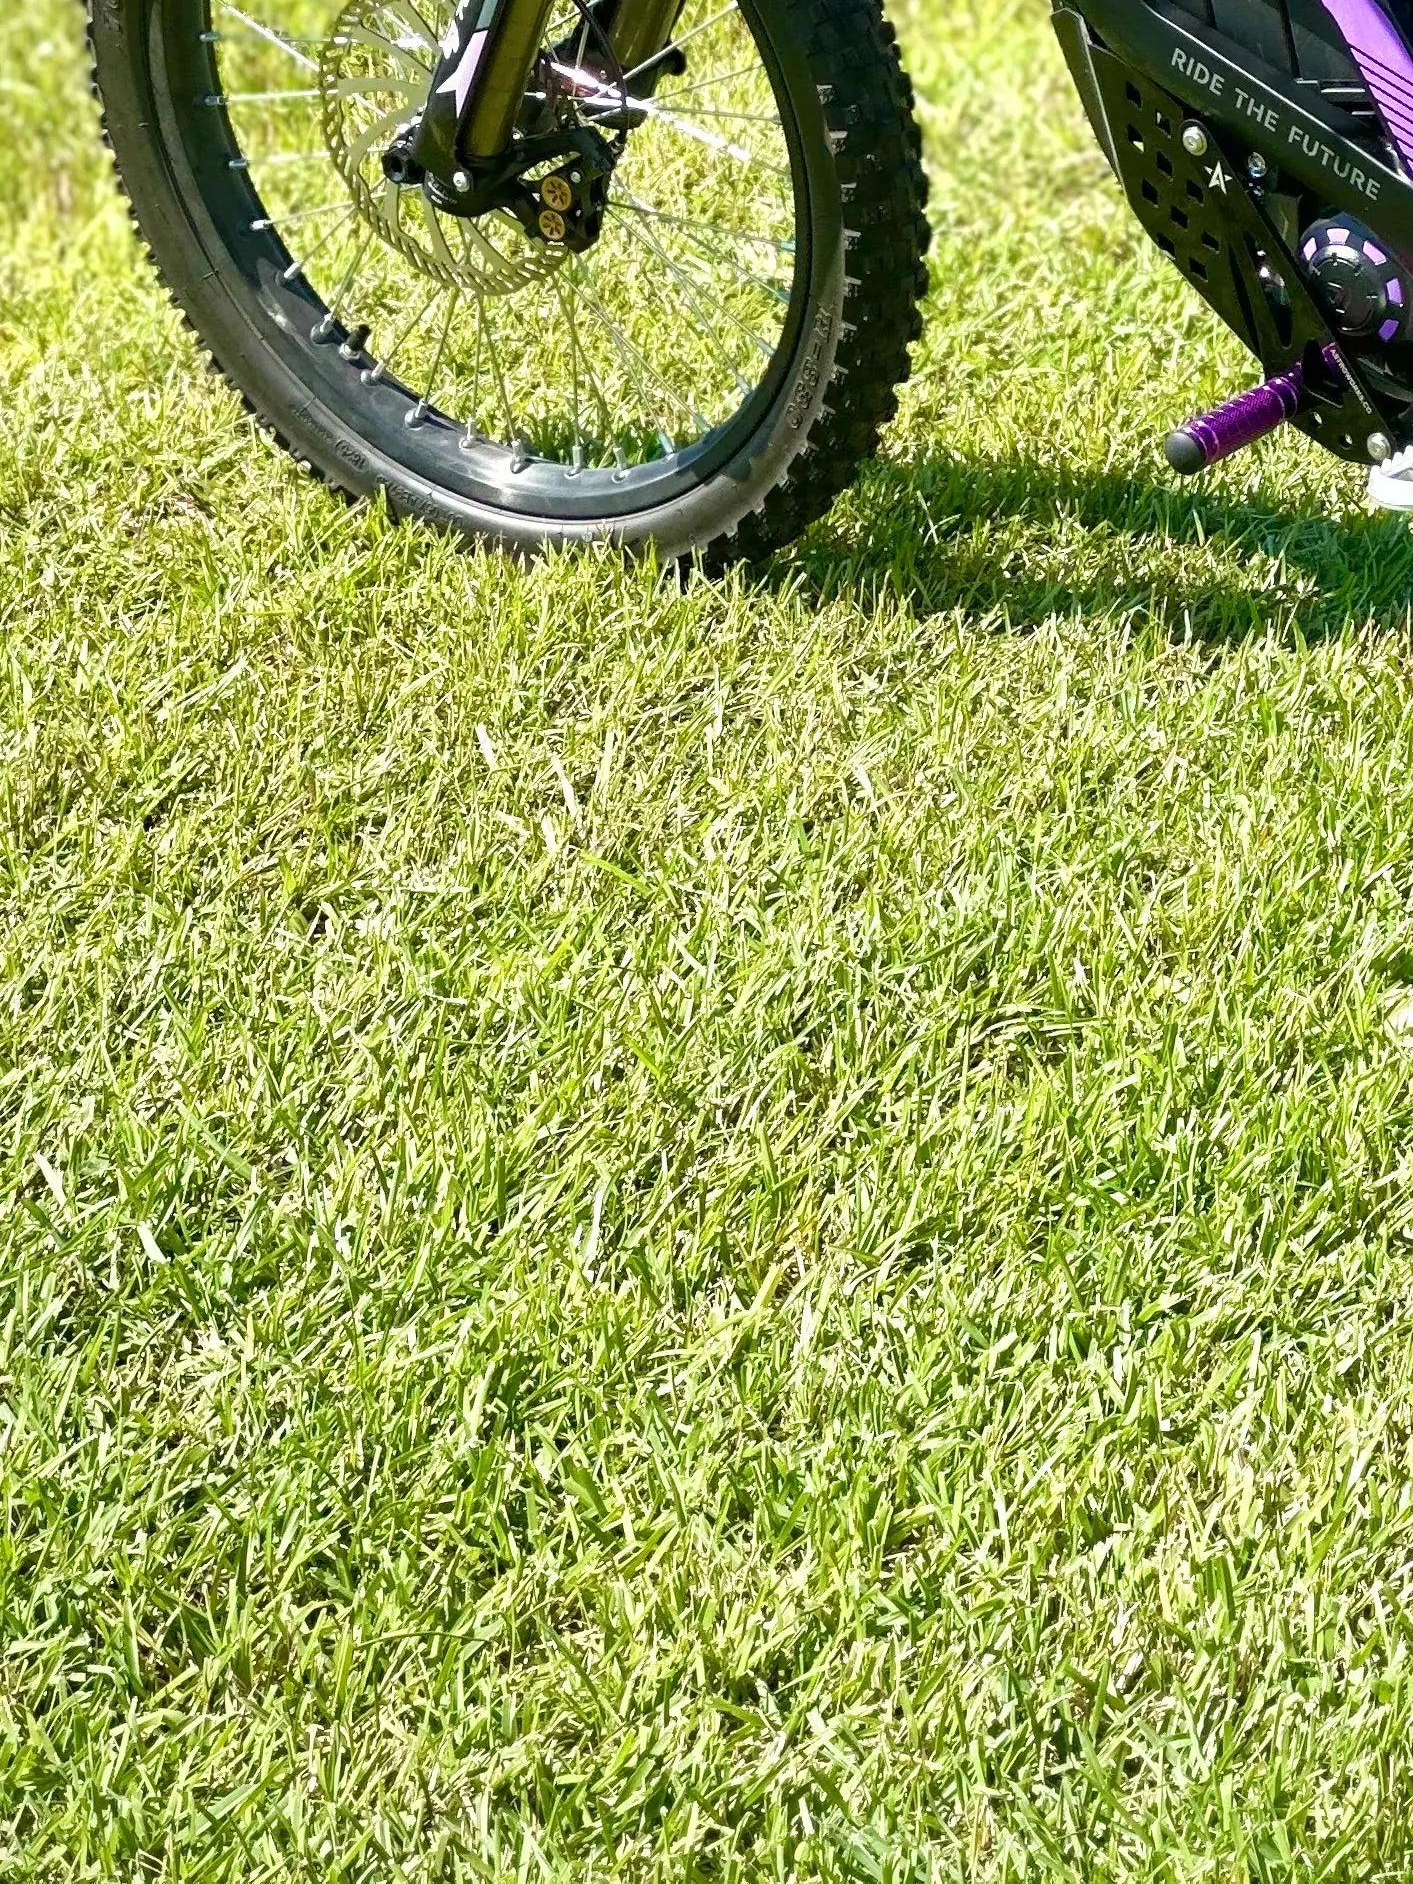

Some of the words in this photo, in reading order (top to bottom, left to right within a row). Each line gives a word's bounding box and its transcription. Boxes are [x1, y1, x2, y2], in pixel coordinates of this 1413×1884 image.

[1171, 47, 1225, 96] RIDE
[1234, 87, 1280, 133] THE
[1287, 125, 1382, 201] FUTURE
